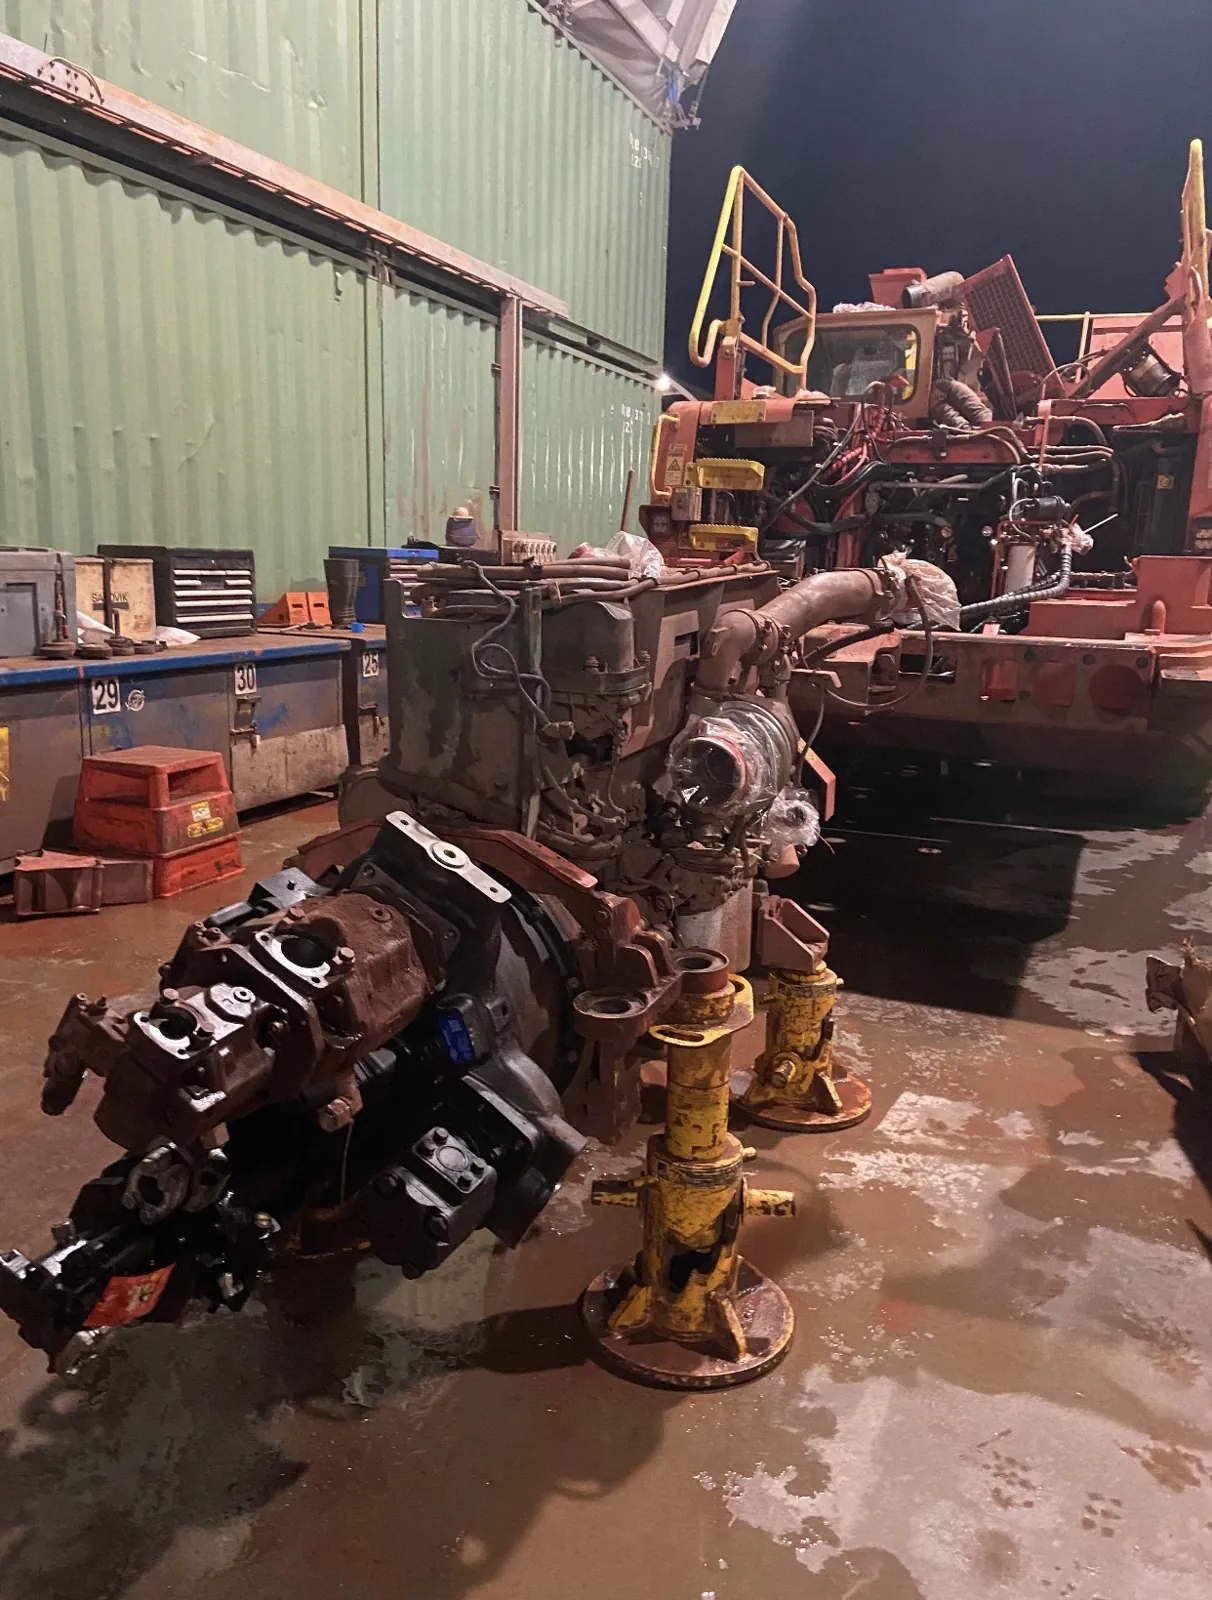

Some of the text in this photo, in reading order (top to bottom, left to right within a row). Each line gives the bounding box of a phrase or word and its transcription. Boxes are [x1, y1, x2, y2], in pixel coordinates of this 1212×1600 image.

[92, 592, 128, 602] SADVIK
[364, 652, 378, 674] 25
[237, 664, 255, 691] 30
[95, 680, 118, 710] 29
